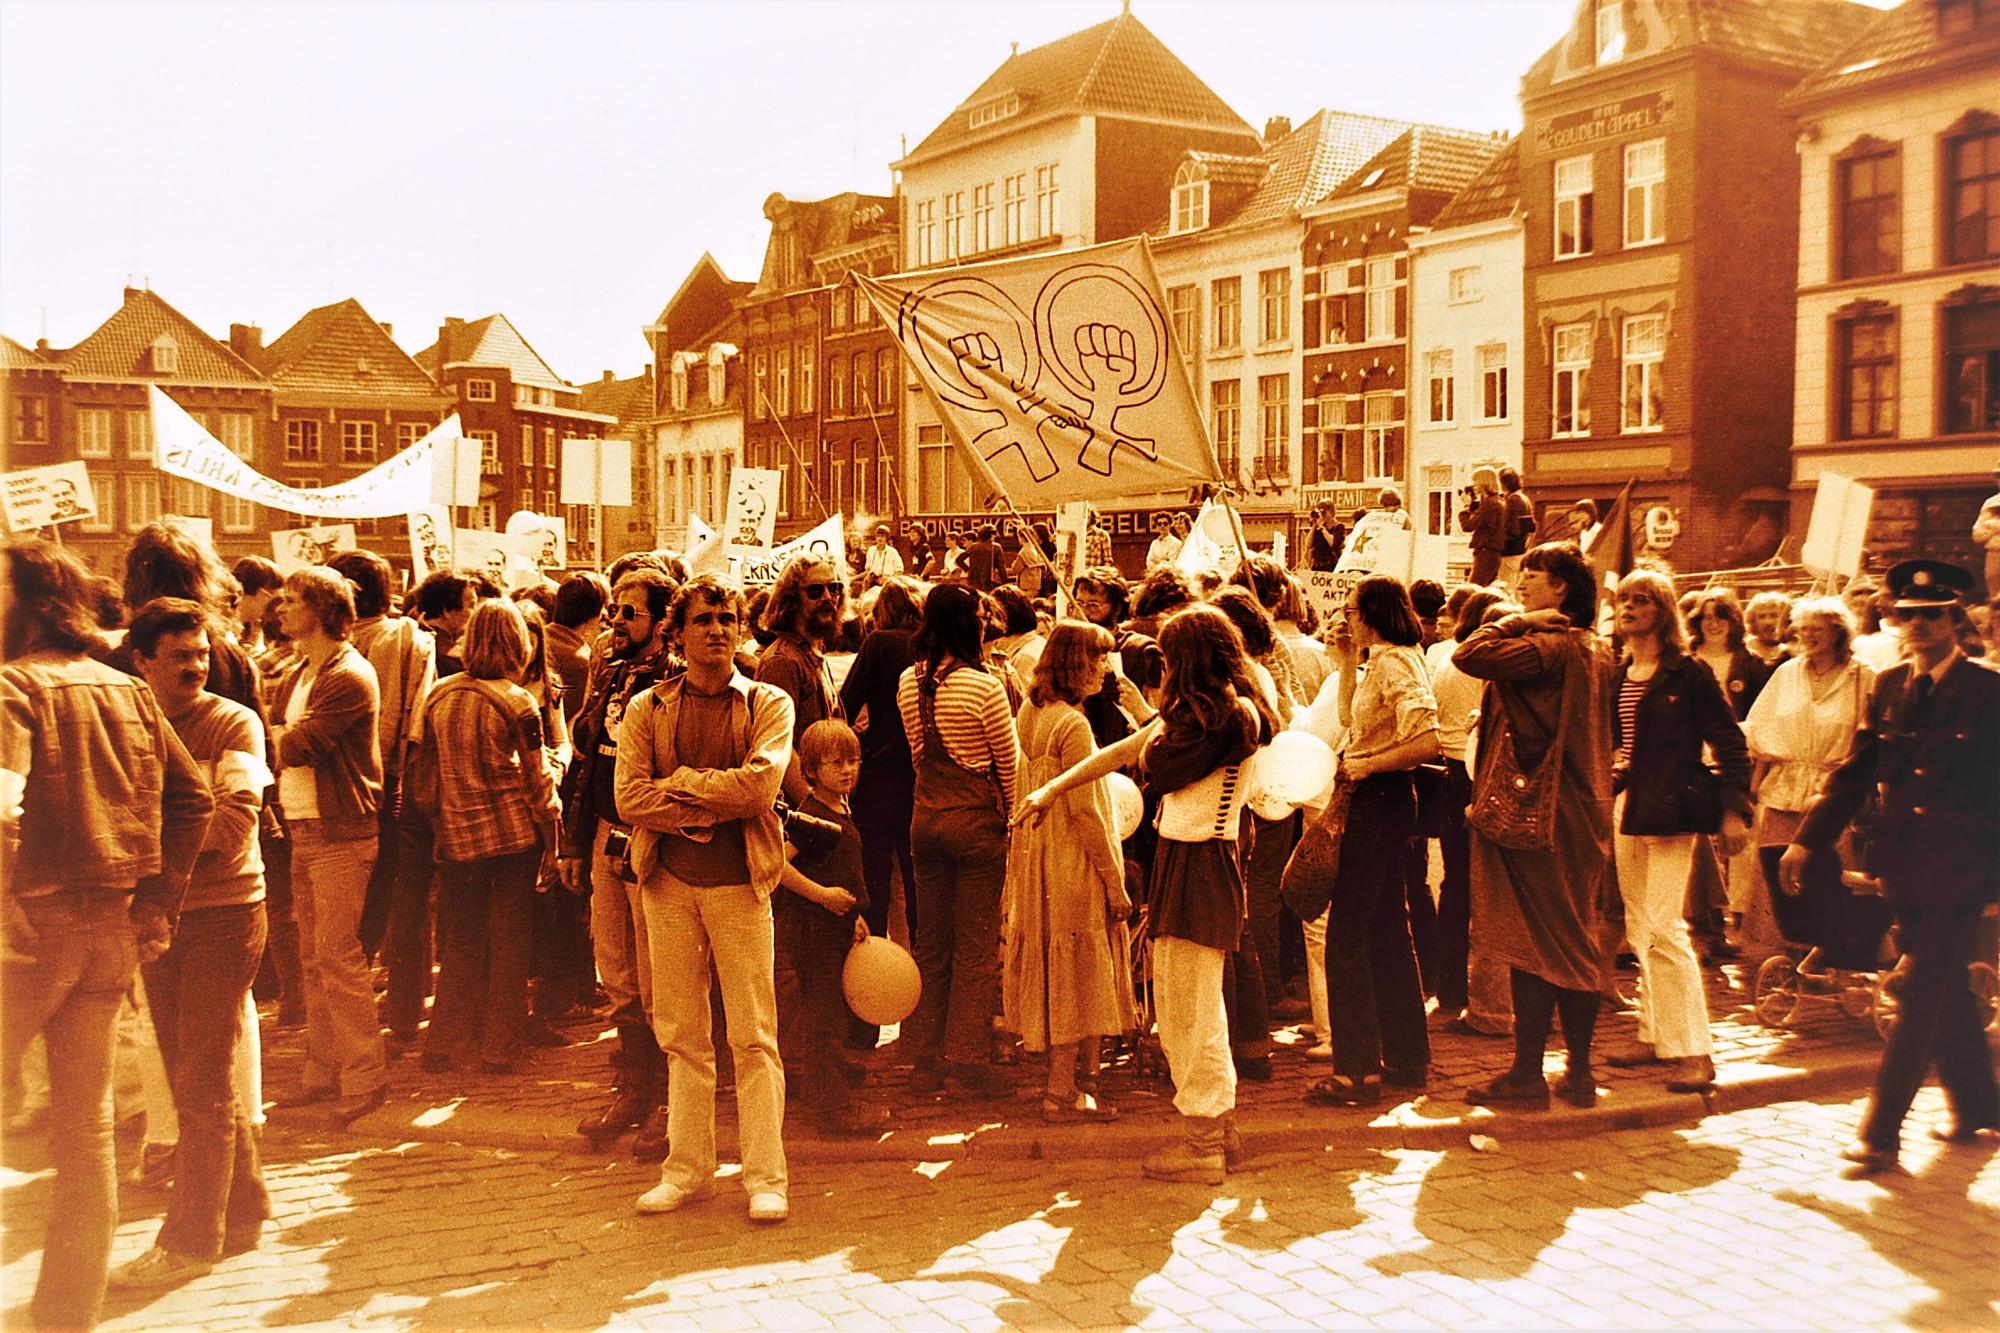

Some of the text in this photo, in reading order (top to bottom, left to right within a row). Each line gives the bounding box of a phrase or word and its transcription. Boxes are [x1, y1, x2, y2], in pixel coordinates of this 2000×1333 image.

[1554, 108, 1654, 147] GOUDEN APPEL
[900, 518, 964, 537] BONS
